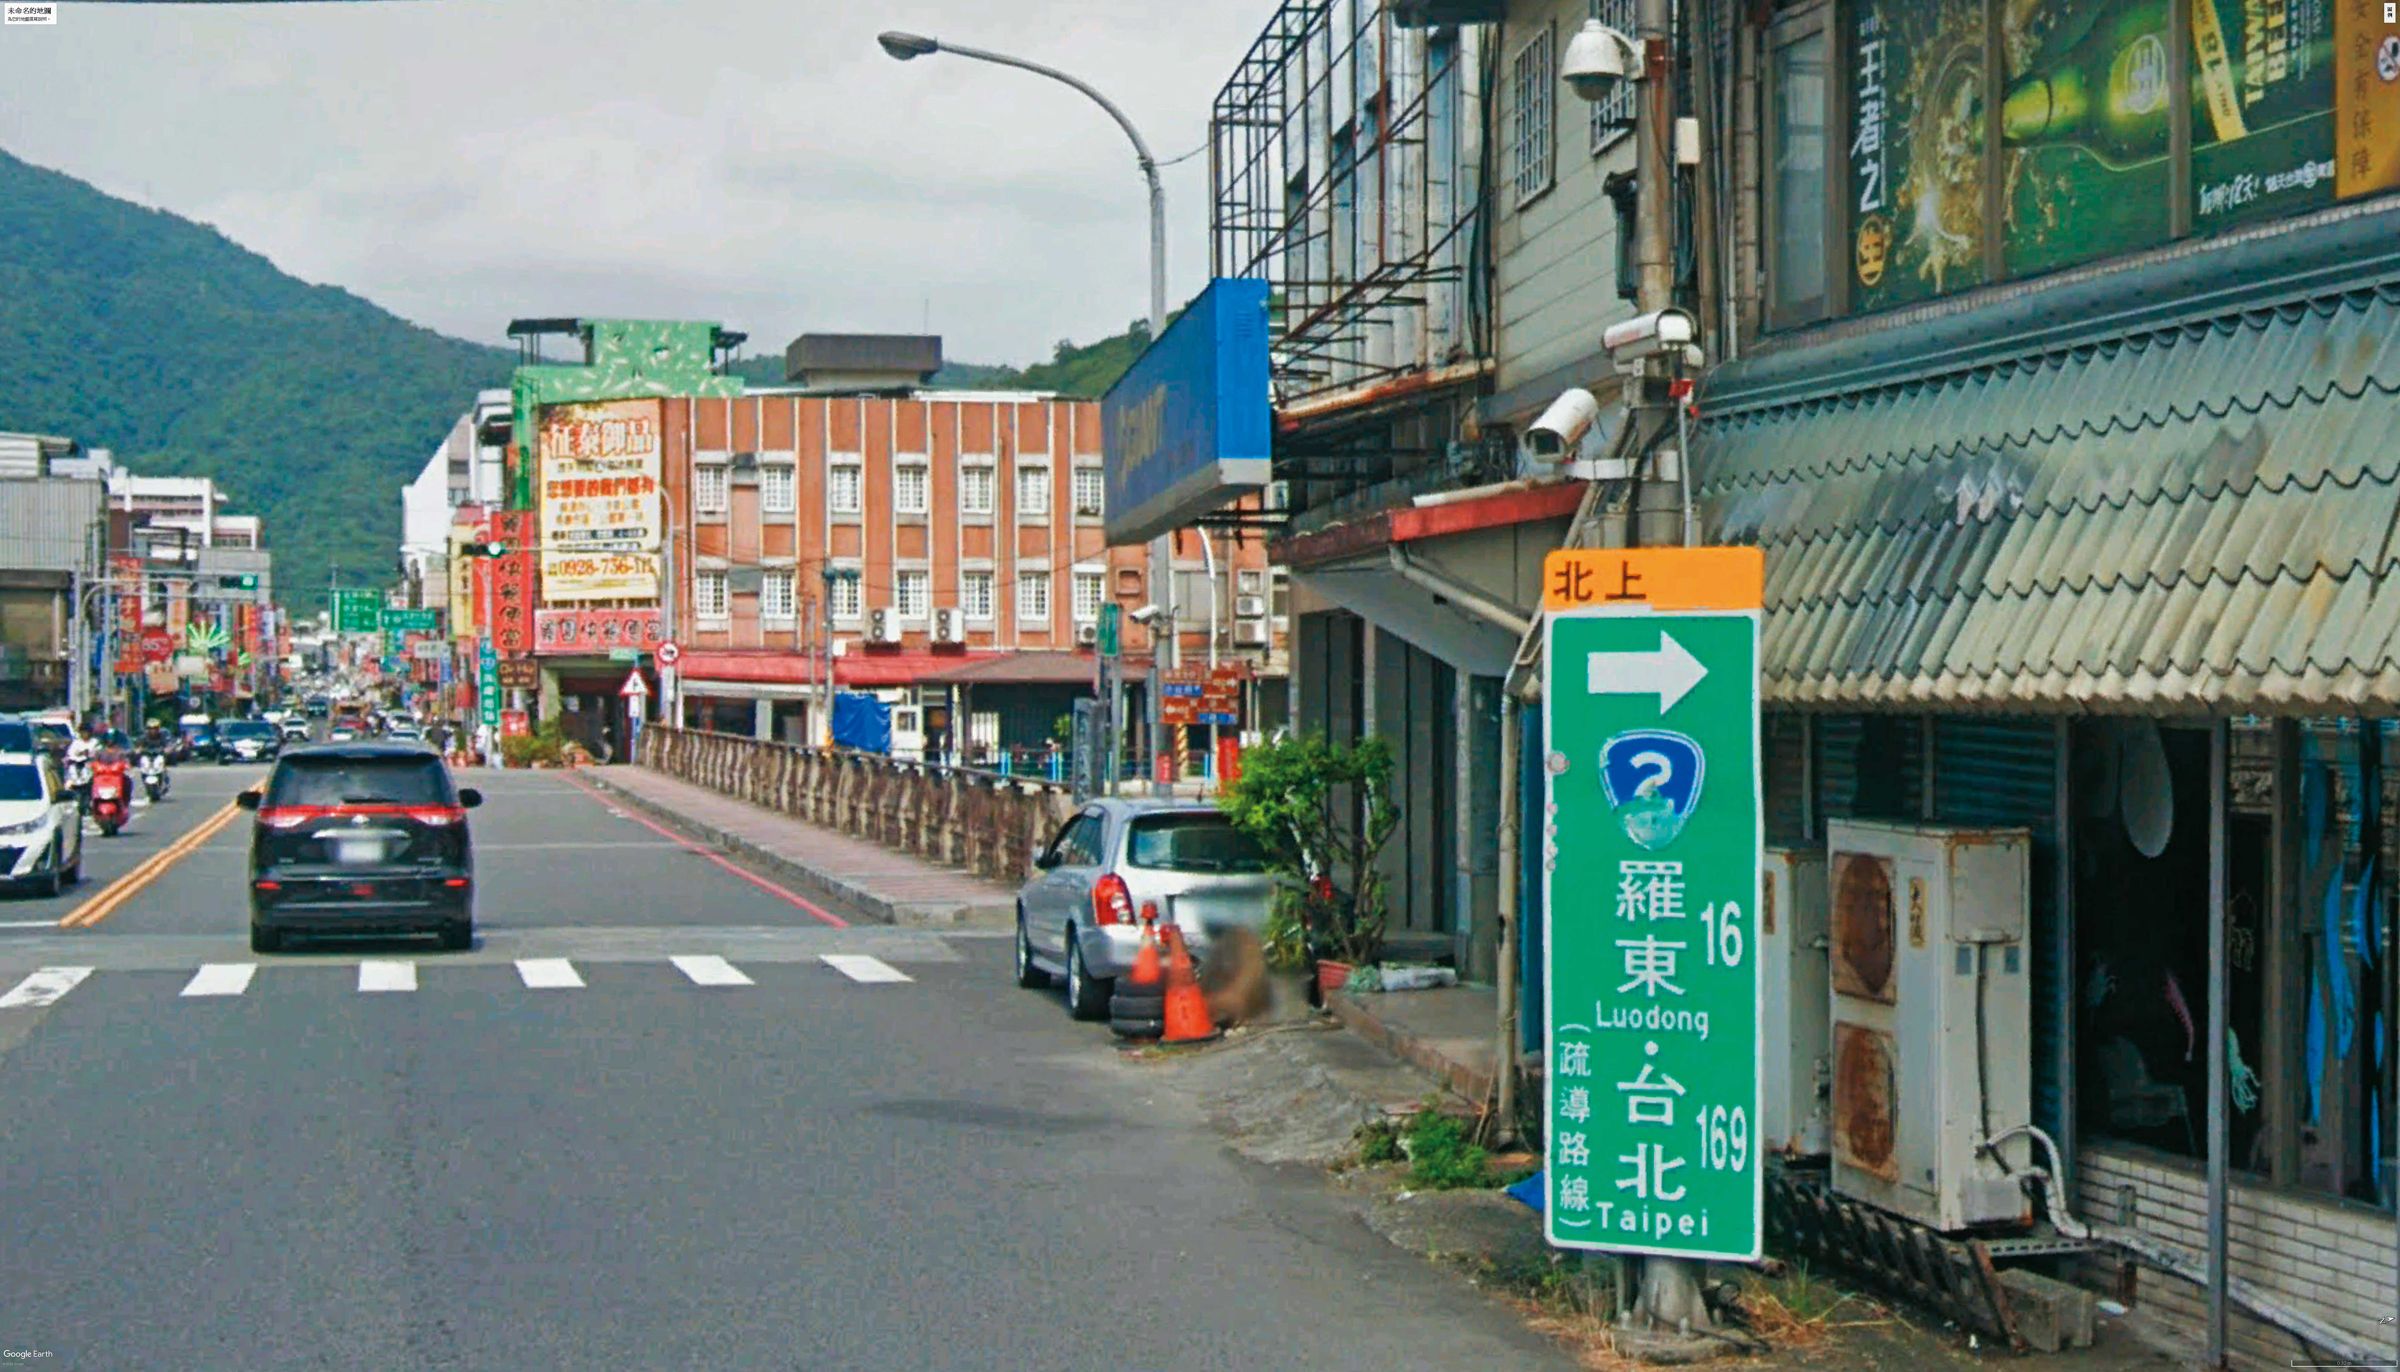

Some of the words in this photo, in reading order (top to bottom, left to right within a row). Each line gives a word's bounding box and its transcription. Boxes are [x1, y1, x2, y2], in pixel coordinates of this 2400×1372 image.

[2267, 0, 2287, 83] BEE
[1553, 560, 1647, 601] 北上
[1615, 860, 1687, 997] 羅東
[1700, 901, 1743, 967] 16
[1596, 1000, 1709, 1041] Luodong
[1615, 1063, 1687, 1201] 台北
[1696, 1104, 1748, 1173] 169
[1596, 1201, 1709, 1240] Taipei
